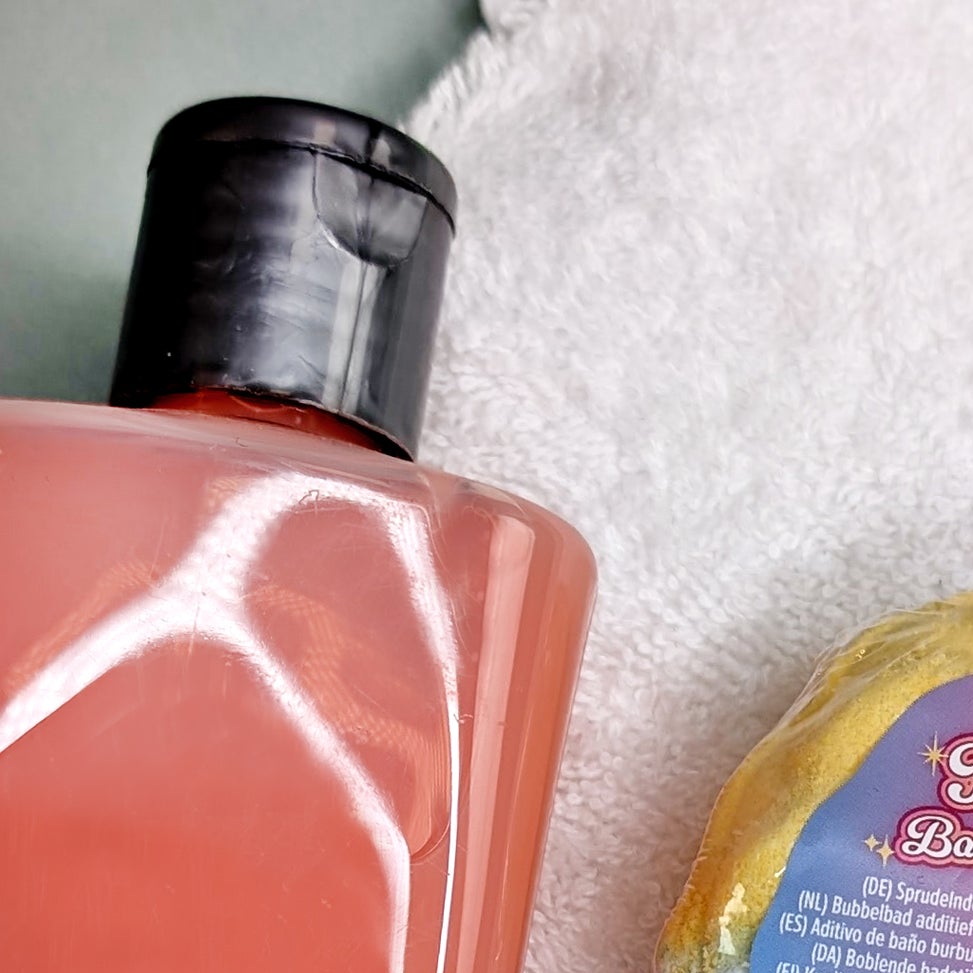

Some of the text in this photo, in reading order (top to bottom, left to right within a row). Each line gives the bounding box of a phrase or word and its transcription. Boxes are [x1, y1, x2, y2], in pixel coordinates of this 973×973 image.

[863, 876, 892, 901] (DE)
[798, 890, 828, 915] (NL)
[832, 896, 912, 926] Bubbelbad
[916, 913, 973, 936] additief
[780, 912, 808, 937] (ES)
[811, 920, 861, 943] Aditivo
[866, 928, 885, 946] de
[888, 932, 926, 953] baño
[811, 943, 842, 968] (DA)
